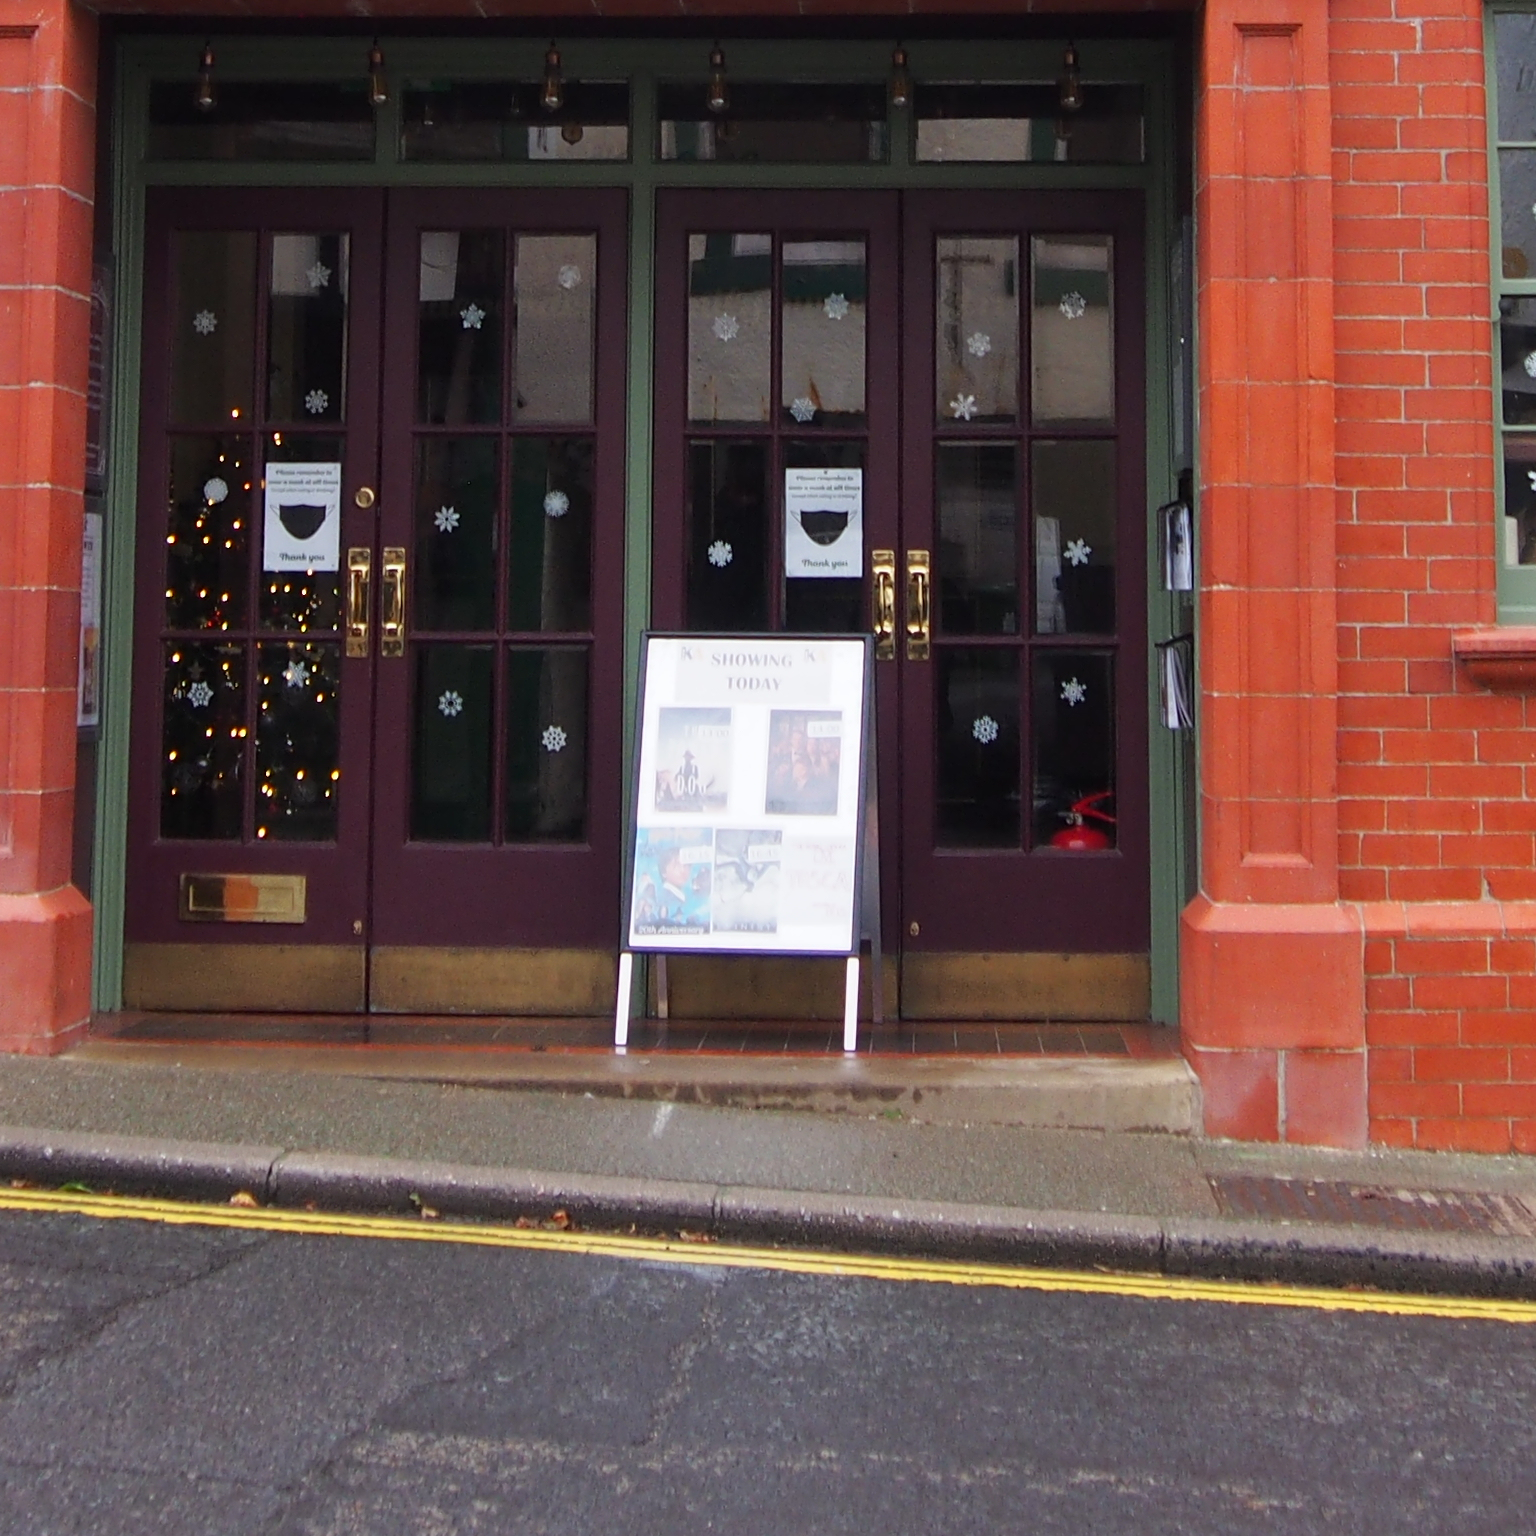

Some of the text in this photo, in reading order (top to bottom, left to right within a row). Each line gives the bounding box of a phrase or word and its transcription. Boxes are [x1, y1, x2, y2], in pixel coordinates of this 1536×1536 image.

[279, 553, 325, 564] Thank you
[711, 652, 793, 668] SHOWING
[726, 676, 783, 691] TODAY
